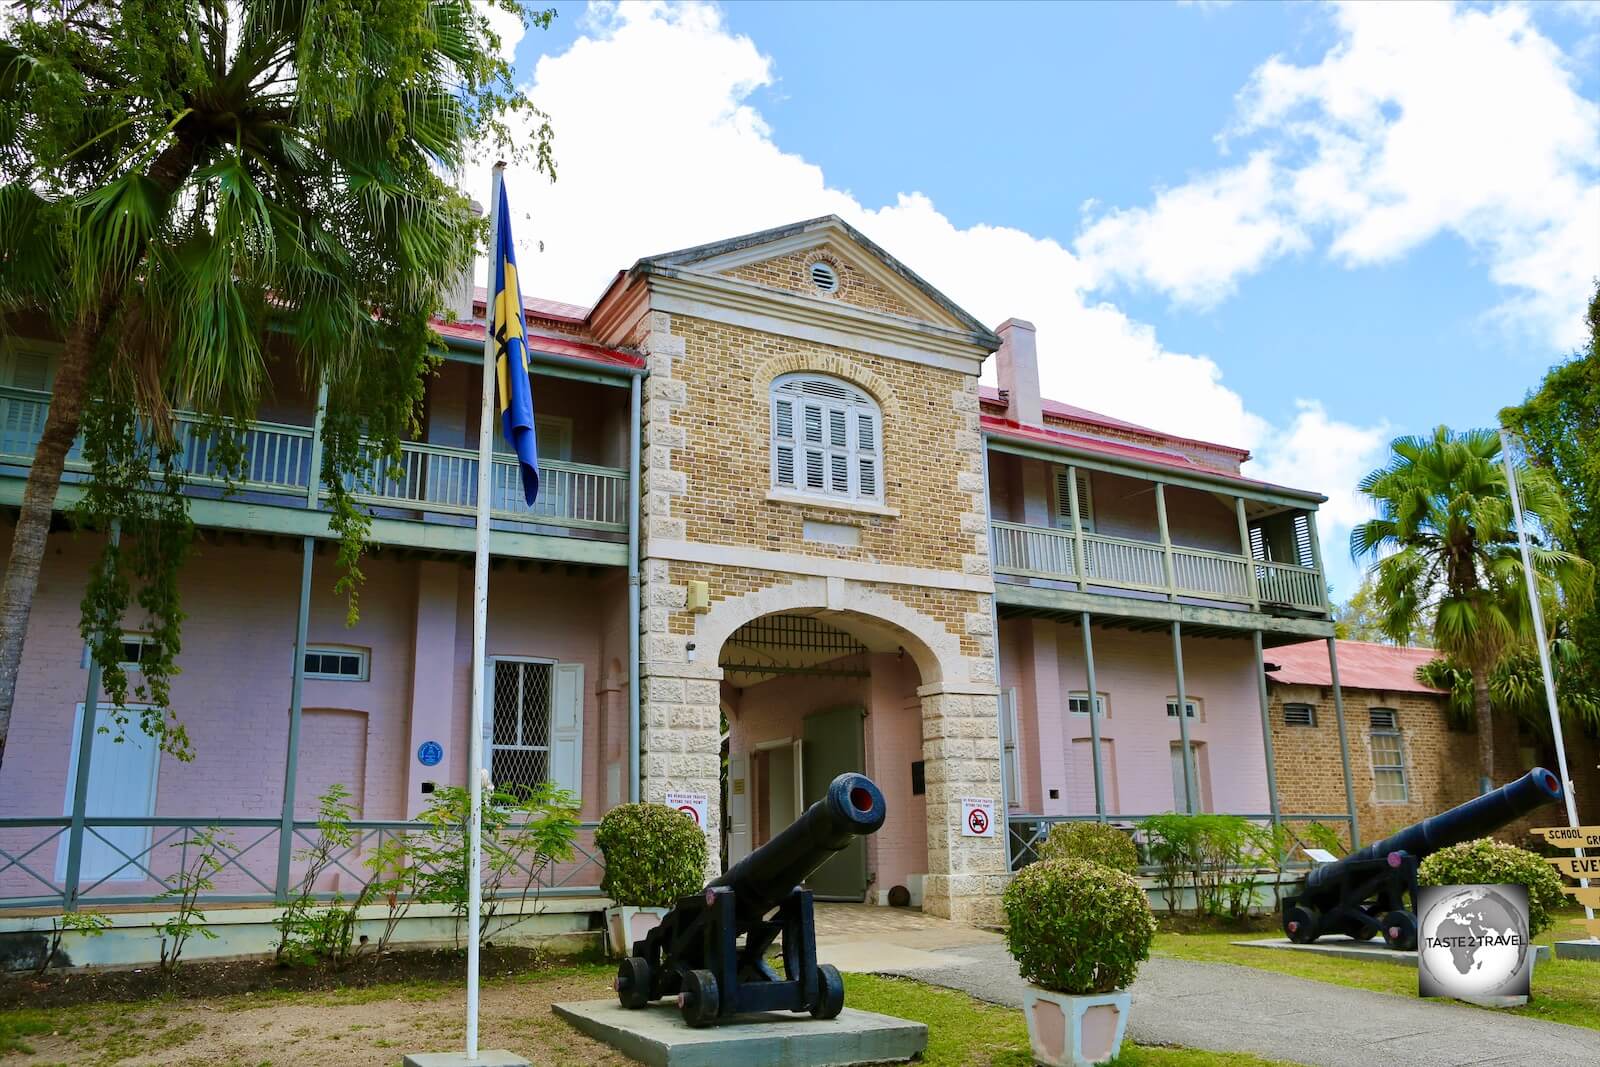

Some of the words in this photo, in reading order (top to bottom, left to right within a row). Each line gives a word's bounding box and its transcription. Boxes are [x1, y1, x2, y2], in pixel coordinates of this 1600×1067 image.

[1549, 829, 1583, 839] SCHOOL
[1587, 836, 1600, 845] GR
[1571, 860, 1600, 872] EVE
